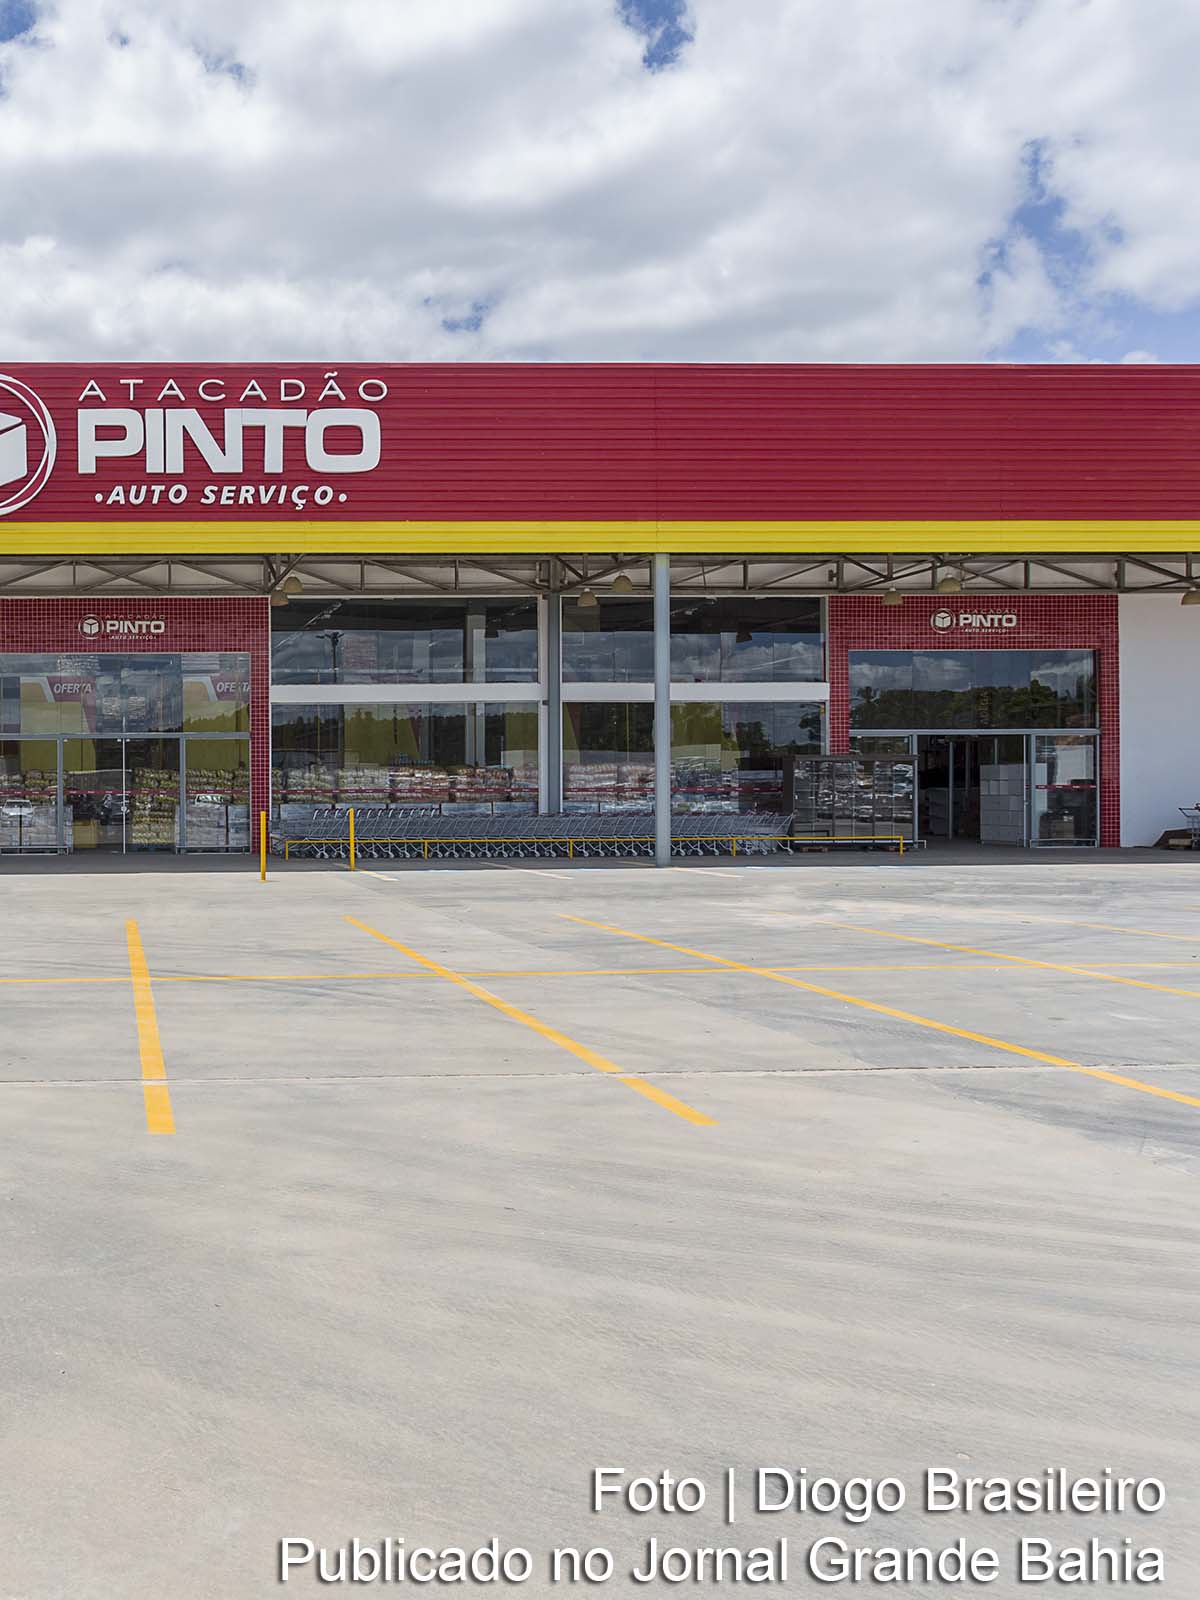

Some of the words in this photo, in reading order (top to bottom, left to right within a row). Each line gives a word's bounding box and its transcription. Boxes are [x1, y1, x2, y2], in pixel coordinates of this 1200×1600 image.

[78, 371, 389, 402] ATACADÃO
[77, 408, 382, 474] PINTO
[106, 620, 165, 633] PINTO
[959, 614, 1017, 627] PINTO
